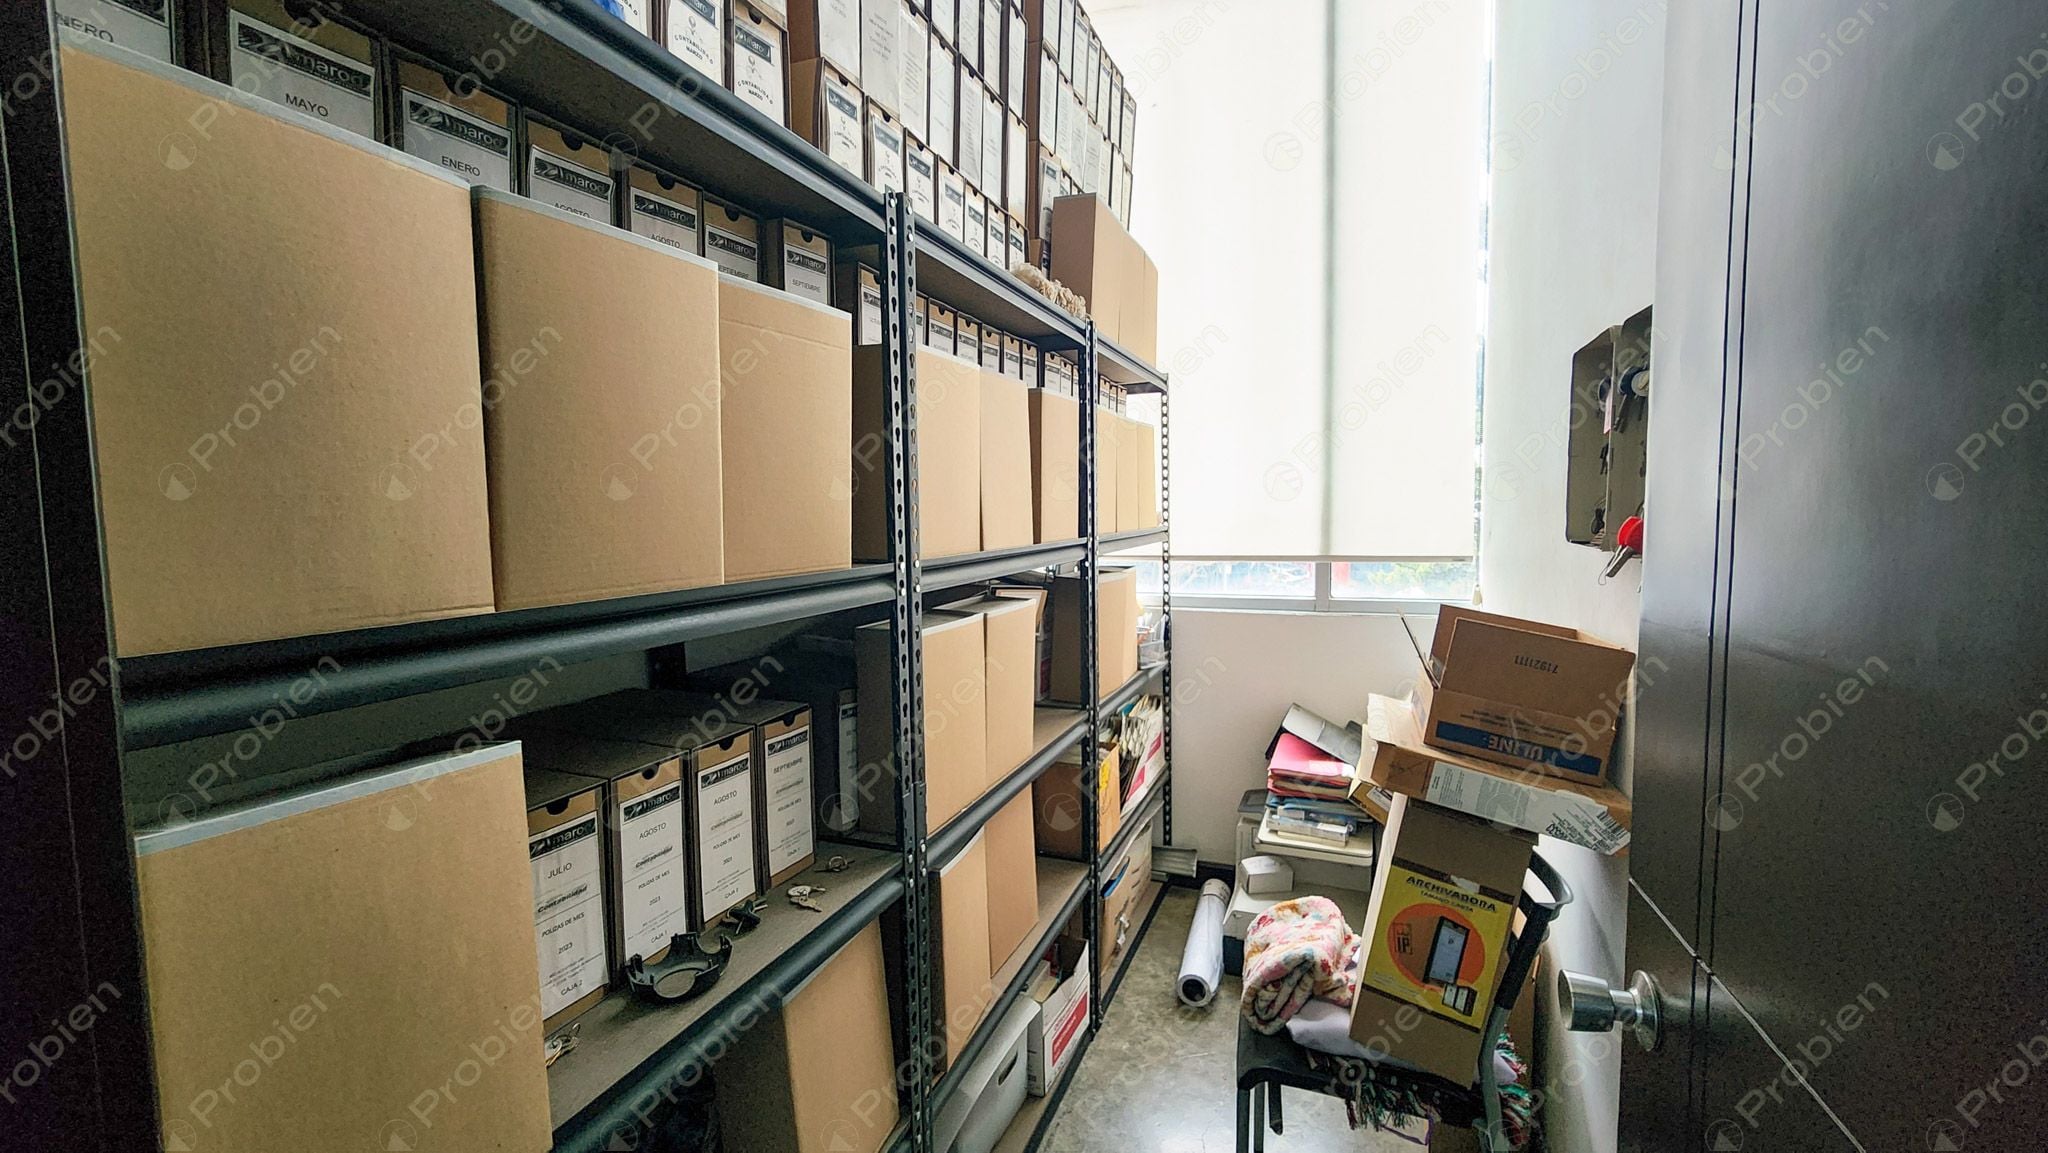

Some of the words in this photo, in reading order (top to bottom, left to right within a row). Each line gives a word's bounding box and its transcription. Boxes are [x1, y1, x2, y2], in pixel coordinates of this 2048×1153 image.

[57, 11, 114, 42] NERO
[285, 92, 328, 117] MAYO
[441, 155, 481, 177] ENERO
[651, 233, 681, 249] AGOSTO
[1487, 735, 1543, 761] ULINE
[713, 789, 738, 806] AGOSTO
[639, 822, 667, 840] AGOSTO
[547, 862, 573, 879] JULIO
[1405, 875, 1498, 913] ARCHIVADORA
[560, 983, 578, 996] CAJA
